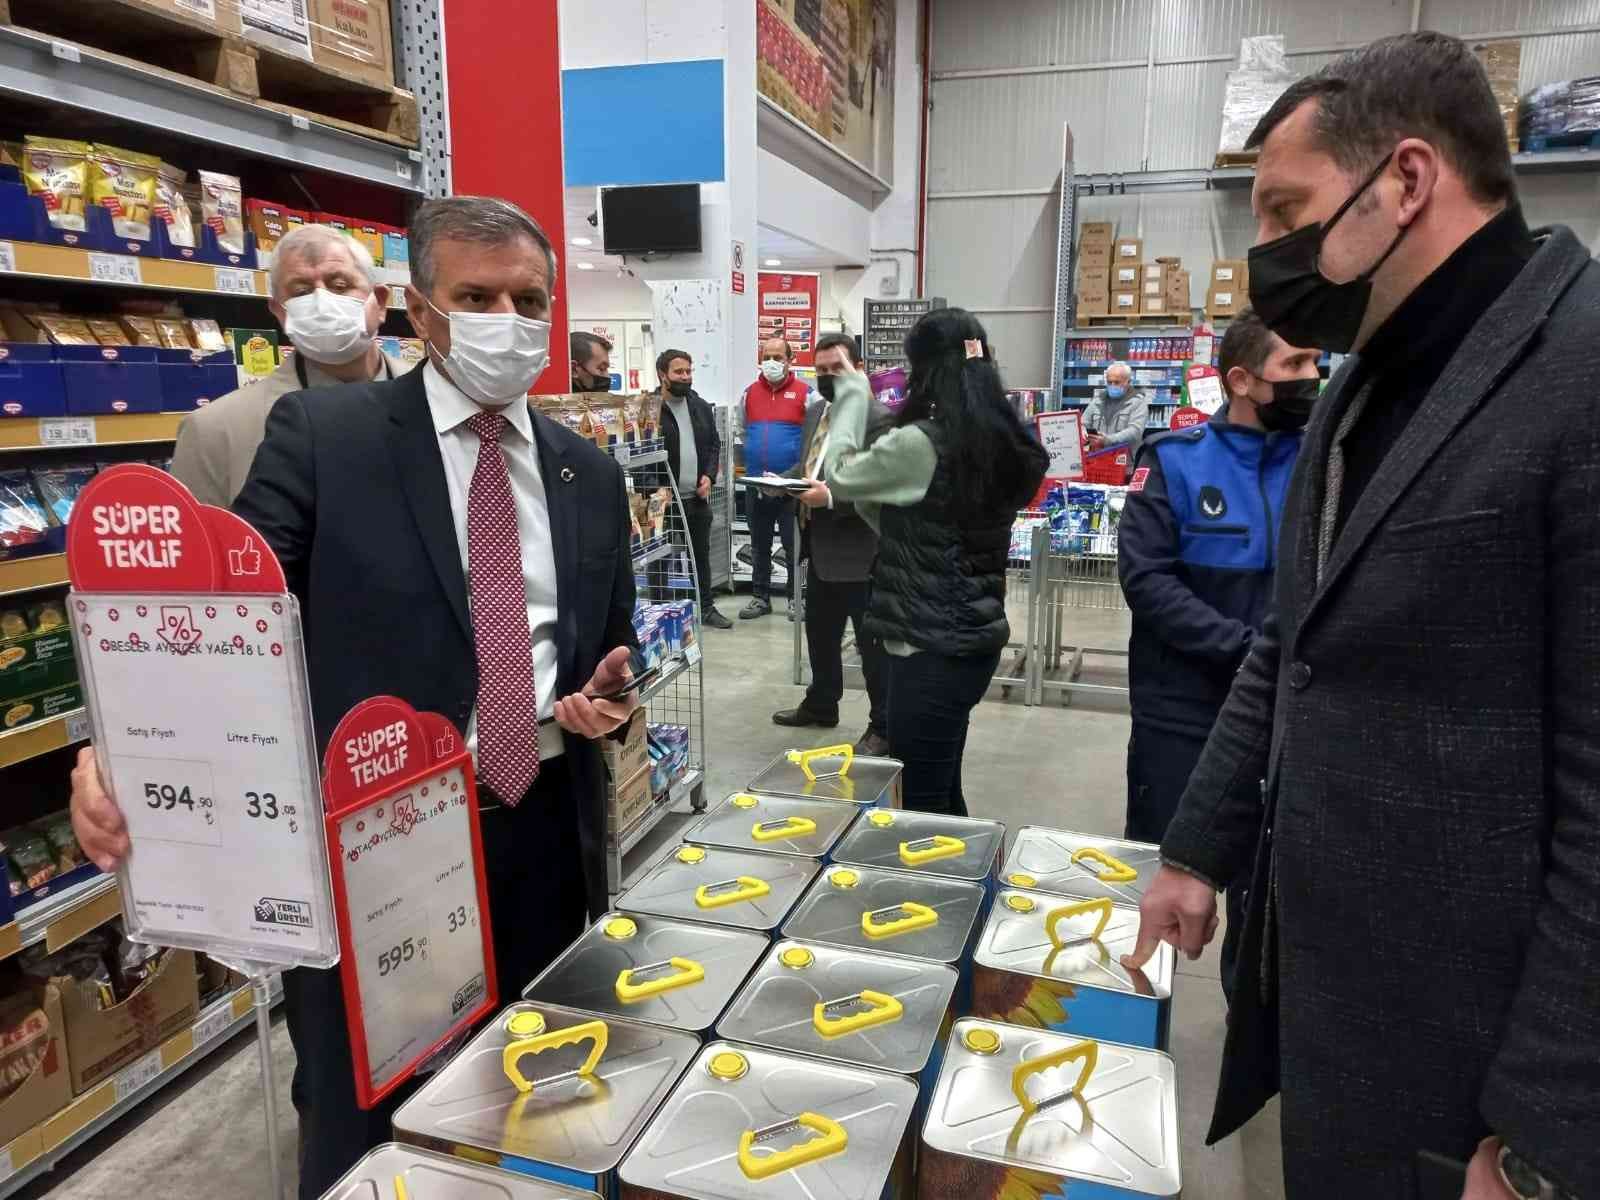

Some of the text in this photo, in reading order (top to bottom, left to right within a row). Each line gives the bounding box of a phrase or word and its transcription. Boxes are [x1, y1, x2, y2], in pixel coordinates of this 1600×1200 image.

[92, 502, 183, 535] SÜPER
[257, 646, 265, 657] L
[127, 727, 149, 739] Satış
[226, 733, 249, 744] Litre
[345, 720, 409, 763] SÜPER
